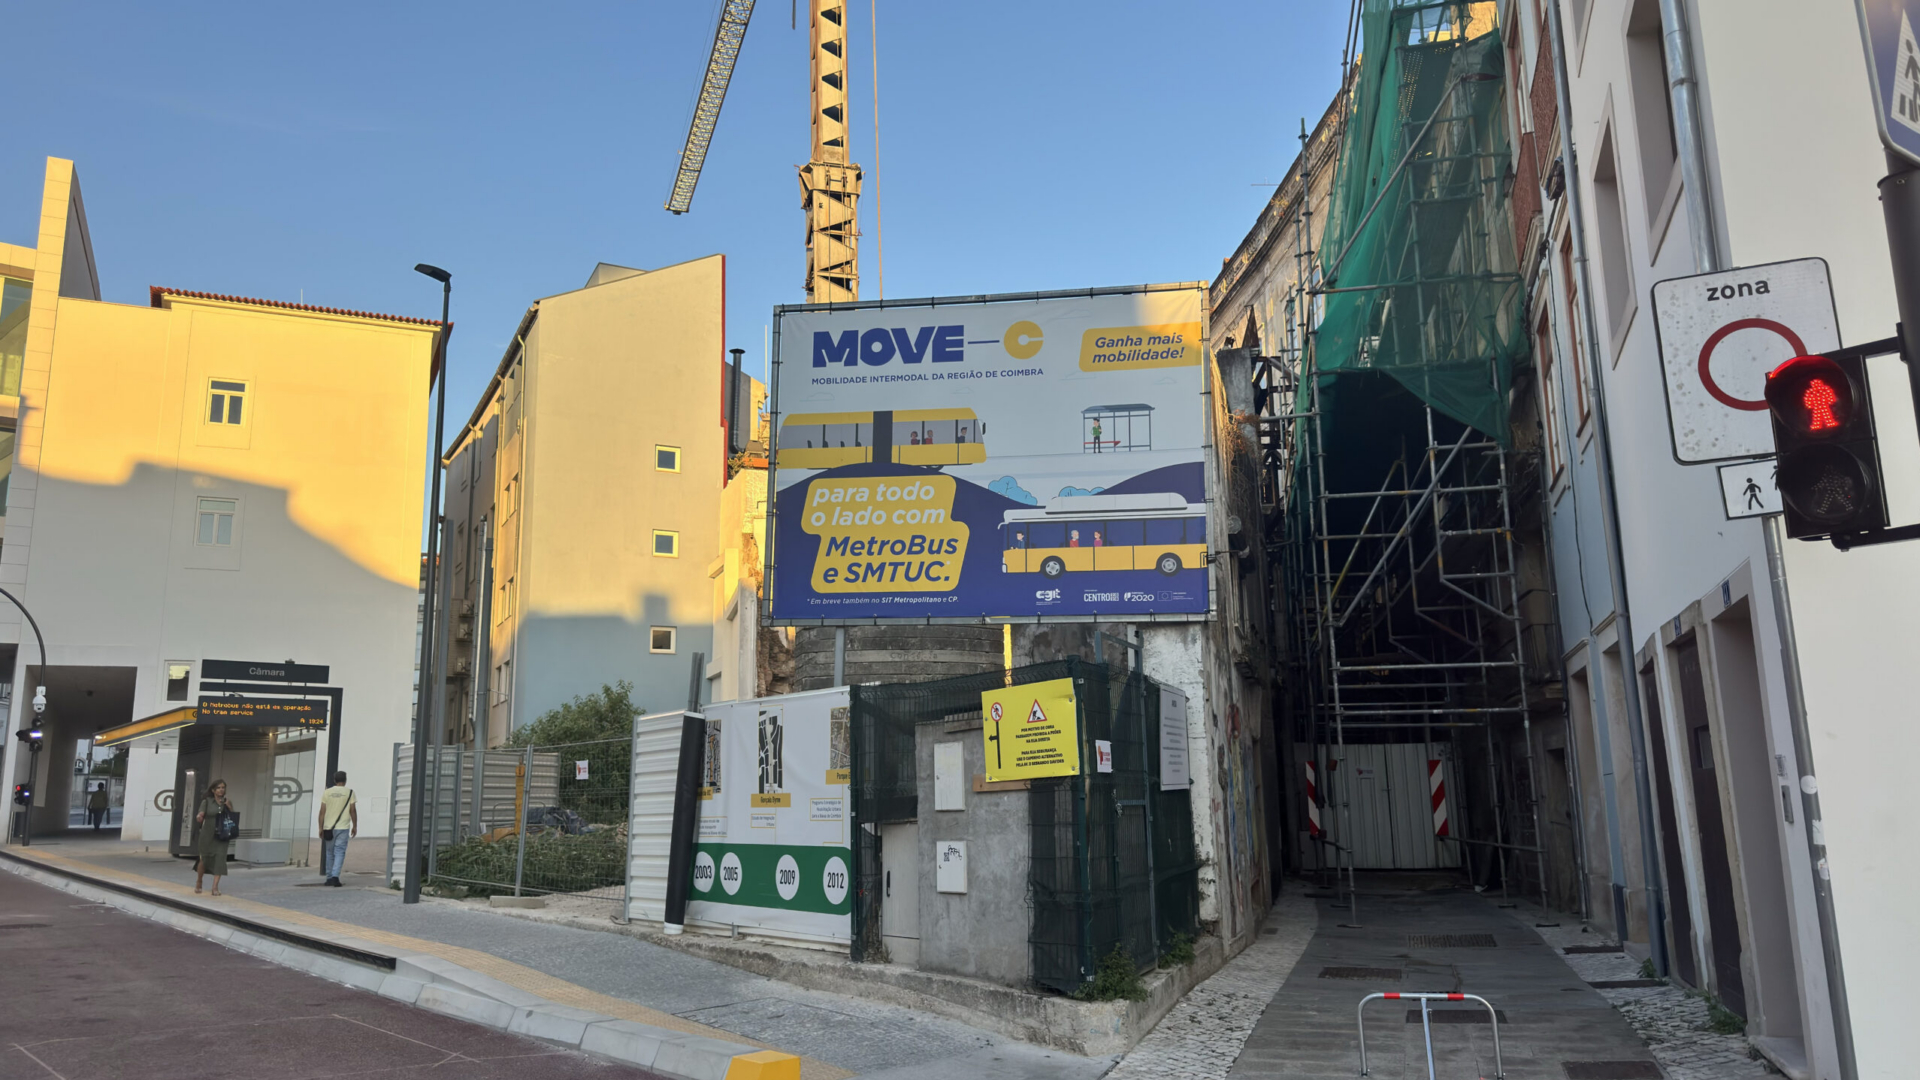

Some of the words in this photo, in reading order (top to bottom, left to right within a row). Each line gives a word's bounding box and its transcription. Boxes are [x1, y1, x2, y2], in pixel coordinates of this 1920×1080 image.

[1706, 280, 1770, 301] zona
[1095, 335, 1142, 348] Ganha
[1147, 332, 1183, 345] mais
[1092, 347, 1185, 363] mobilidade!
[812, 376, 867, 385] MOBILIDADE
[870, 374, 928, 382] INTERMODAL
[948, 370, 982, 380] REGIÃO
[1000, 368, 1044, 377] COIMBRA
[812, 487, 869, 506] para
[876, 481, 935, 501] todo
[811, 512, 826, 526] o
[832, 506, 886, 526] lado
[892, 508, 946, 524] com
[826, 534, 959, 556] MetroBus
[823, 567, 838, 584] e
[1084, 592, 1110, 602] CENTRO
[249, 667, 285, 676] Câmara
[695, 865, 712, 879] 2003
[724, 867, 738, 881] 2005
[780, 870, 795, 885] 2009
[827, 872, 844, 888] 2012
